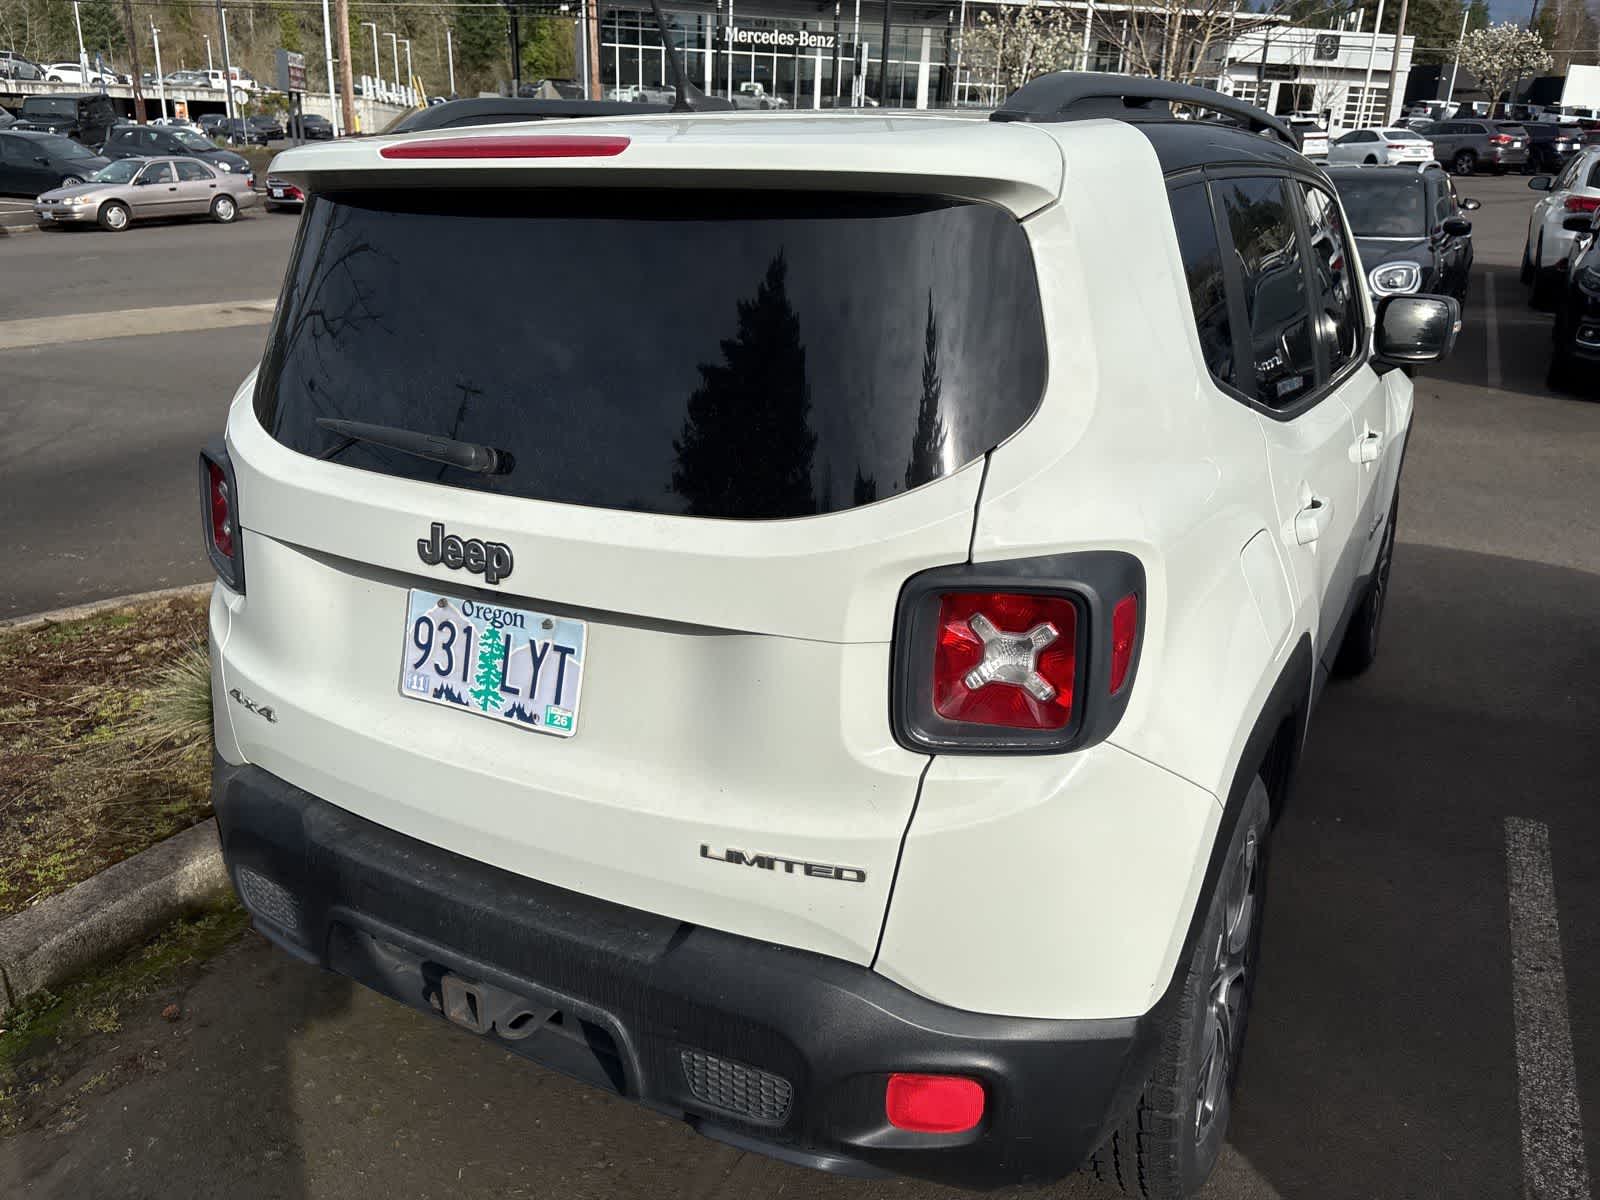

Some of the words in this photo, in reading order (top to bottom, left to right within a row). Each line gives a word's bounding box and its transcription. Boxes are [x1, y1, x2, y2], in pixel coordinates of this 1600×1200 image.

[724, 26, 835, 48] Mercedes-Benz
[417, 521, 514, 585] Jeep
[461, 600, 526, 629] Oregon
[413, 615, 473, 682] 931
[500, 633, 576, 706] LYT
[553, 714, 568, 728] 26
[700, 844, 867, 883] LIMITED
